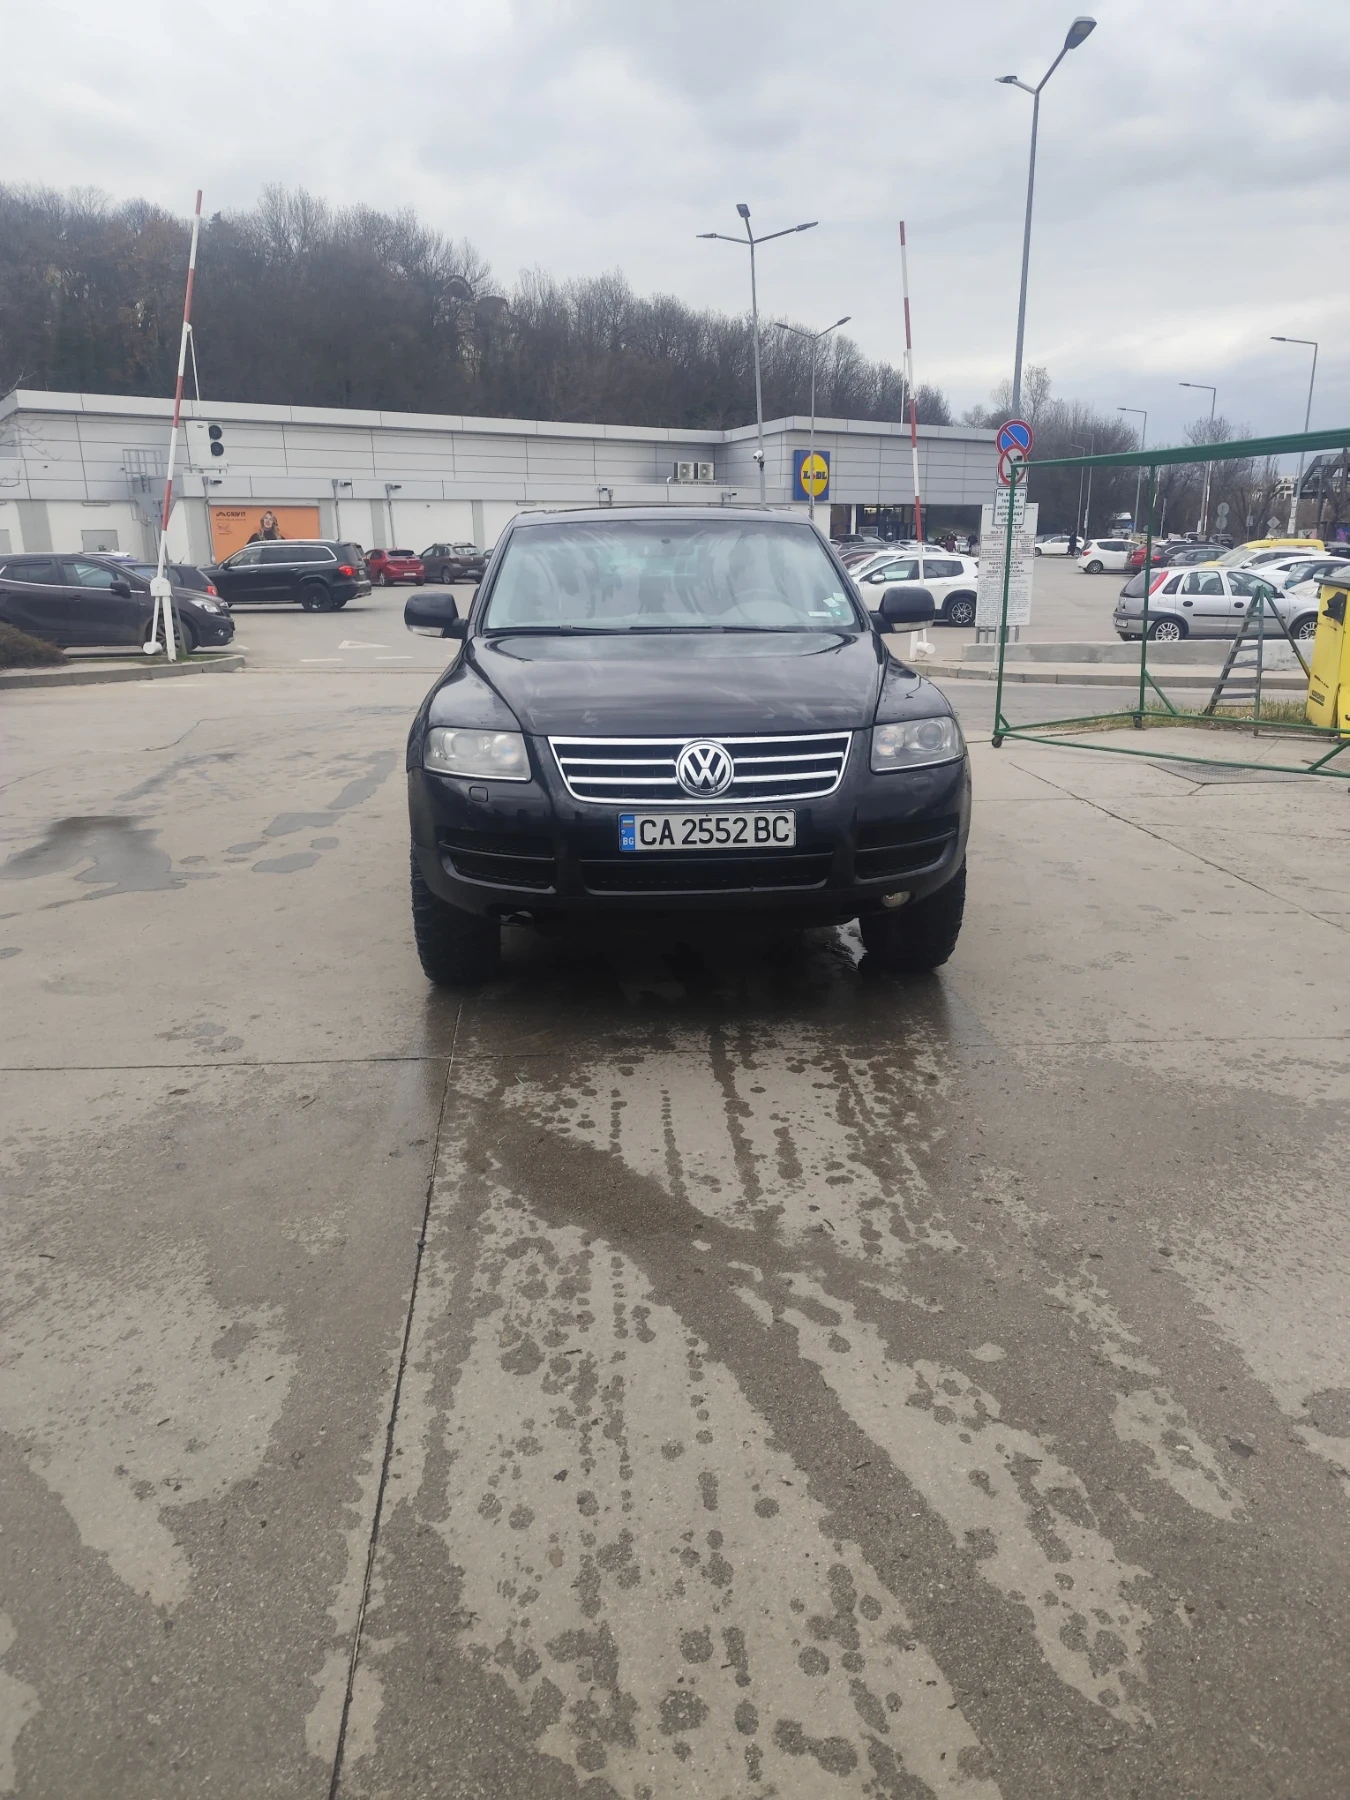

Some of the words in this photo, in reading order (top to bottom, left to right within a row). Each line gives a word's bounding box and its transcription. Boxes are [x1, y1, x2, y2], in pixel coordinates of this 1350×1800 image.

[639, 819, 675, 846] CA
[681, 817, 748, 845] 2552
[754, 815, 790, 843] BC
[622, 837, 634, 846] BG
